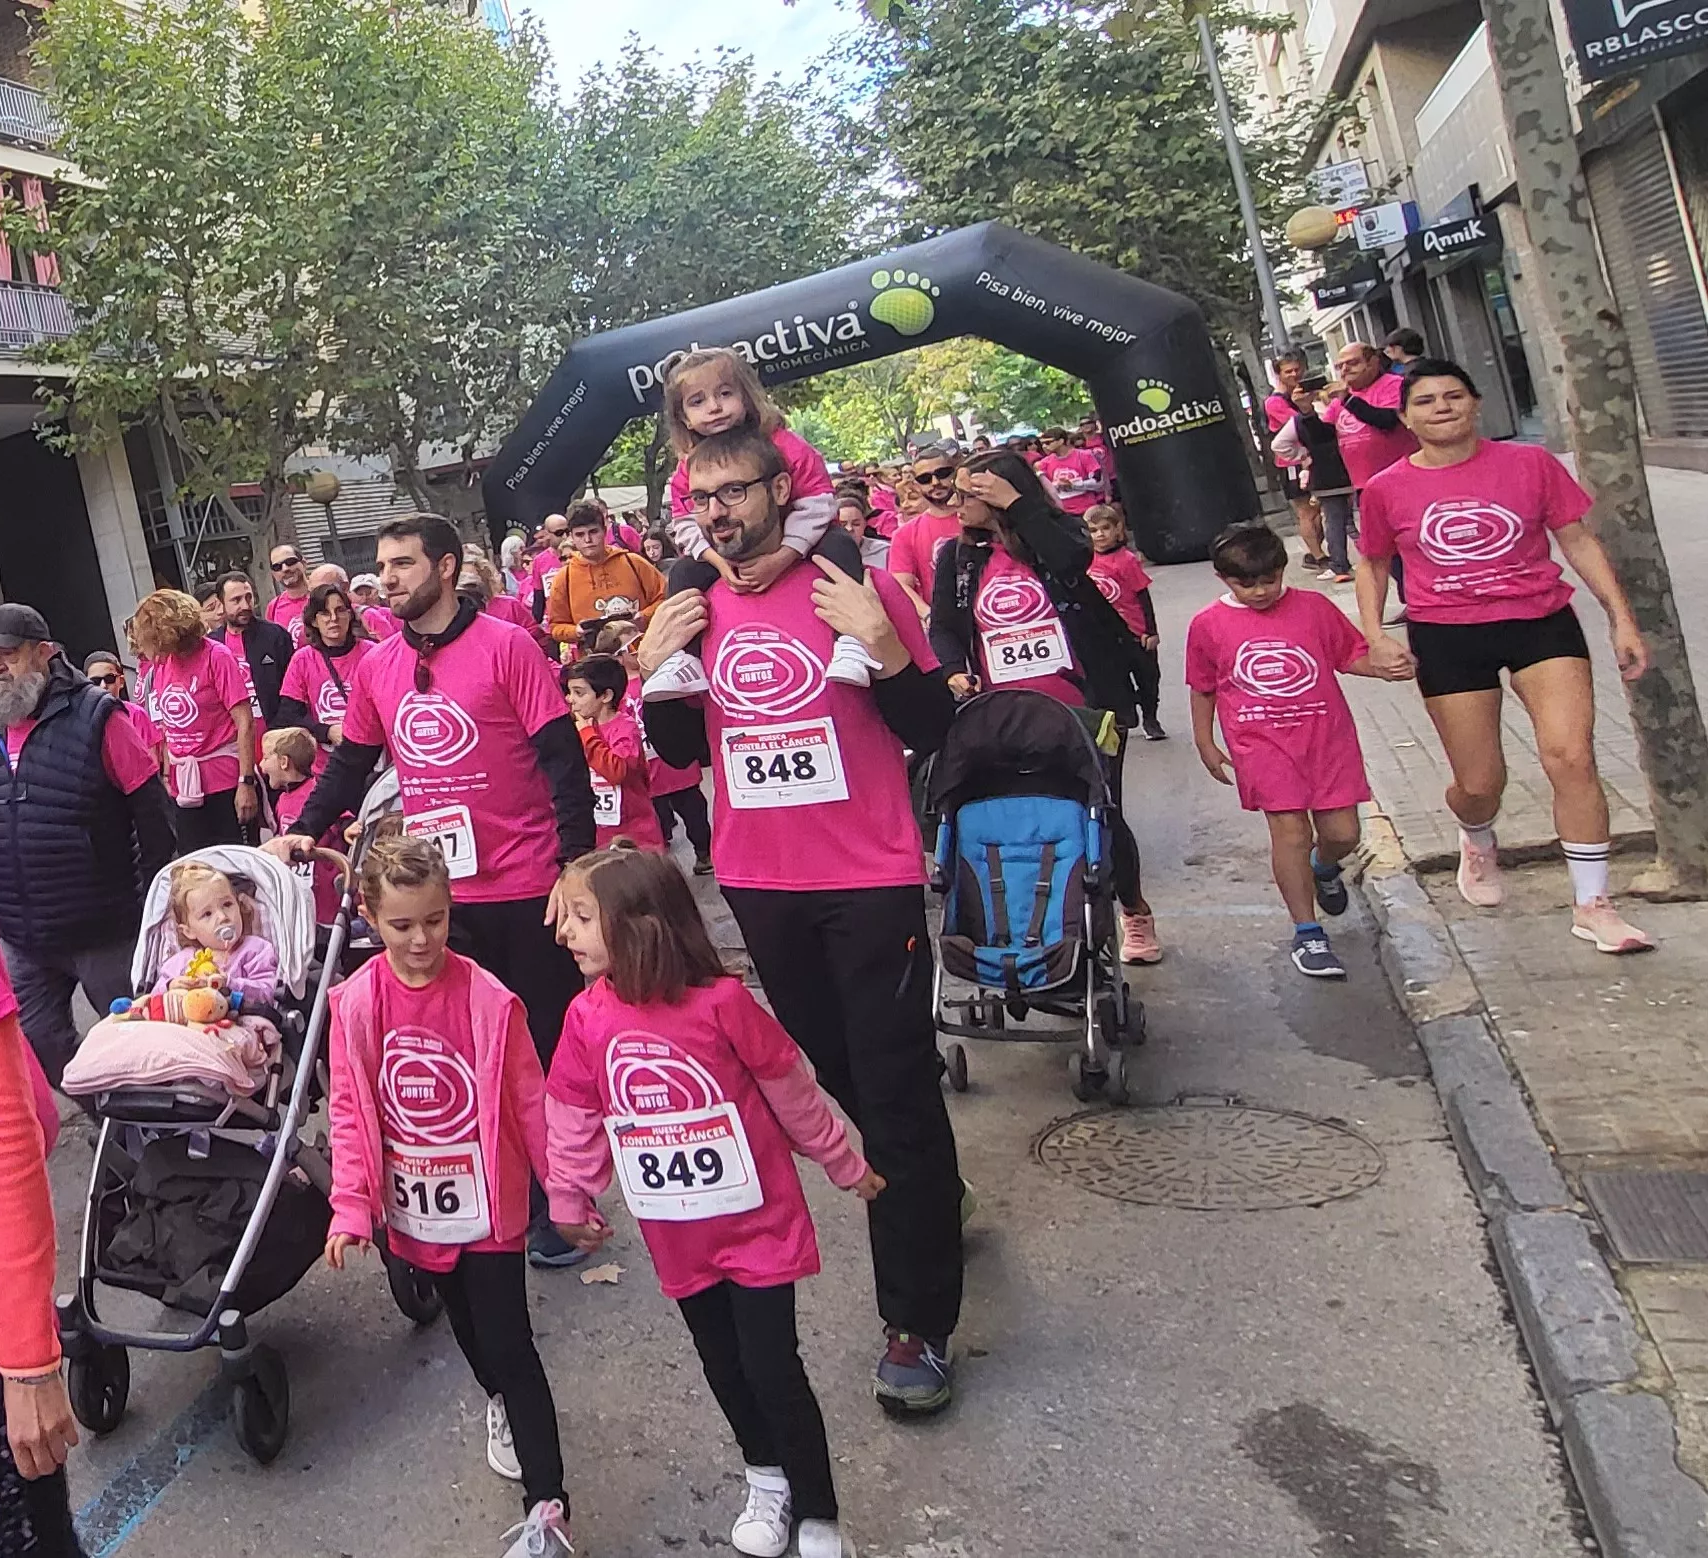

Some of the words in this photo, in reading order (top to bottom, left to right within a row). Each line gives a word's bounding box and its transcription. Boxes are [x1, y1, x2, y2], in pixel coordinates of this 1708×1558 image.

[1585, 7, 1708, 59] RBLASCO
[1424, 219, 1486, 252] Annik
[975, 271, 1009, 296] Pisa
[1011, 286, 1047, 314] bien,
[1053, 304, 1083, 325] vive
[1085, 319, 1136, 345] mejor
[627, 311, 867, 402] poactiva
[765, 338, 872, 374] BIOMECÁNICA
[505, 465, 529, 490] Pisa
[523, 440, 550, 466] bien,
[544, 415, 565, 438] vive
[561, 380, 588, 416] mejor
[1108, 399, 1224, 447] podoactiva
[1002, 639, 1051, 666] 846
[732, 742, 768, 751] CONTRA
[768, 741, 781, 749] EL
[781, 735, 823, 747] CÁNCER
[745, 750, 817, 785] 848
[400, 1086, 435, 1099] JUNTOS
[622, 1134, 664, 1147] CONTRA
[665, 1133, 679, 1145] EL
[680, 1125, 728, 1144] CÁNCER
[652, 1125, 686, 1135] HUESCA
[425, 1163, 469, 1177] CÁNCER
[638, 1147, 724, 1190] 849
[394, 1172, 460, 1215] 516
